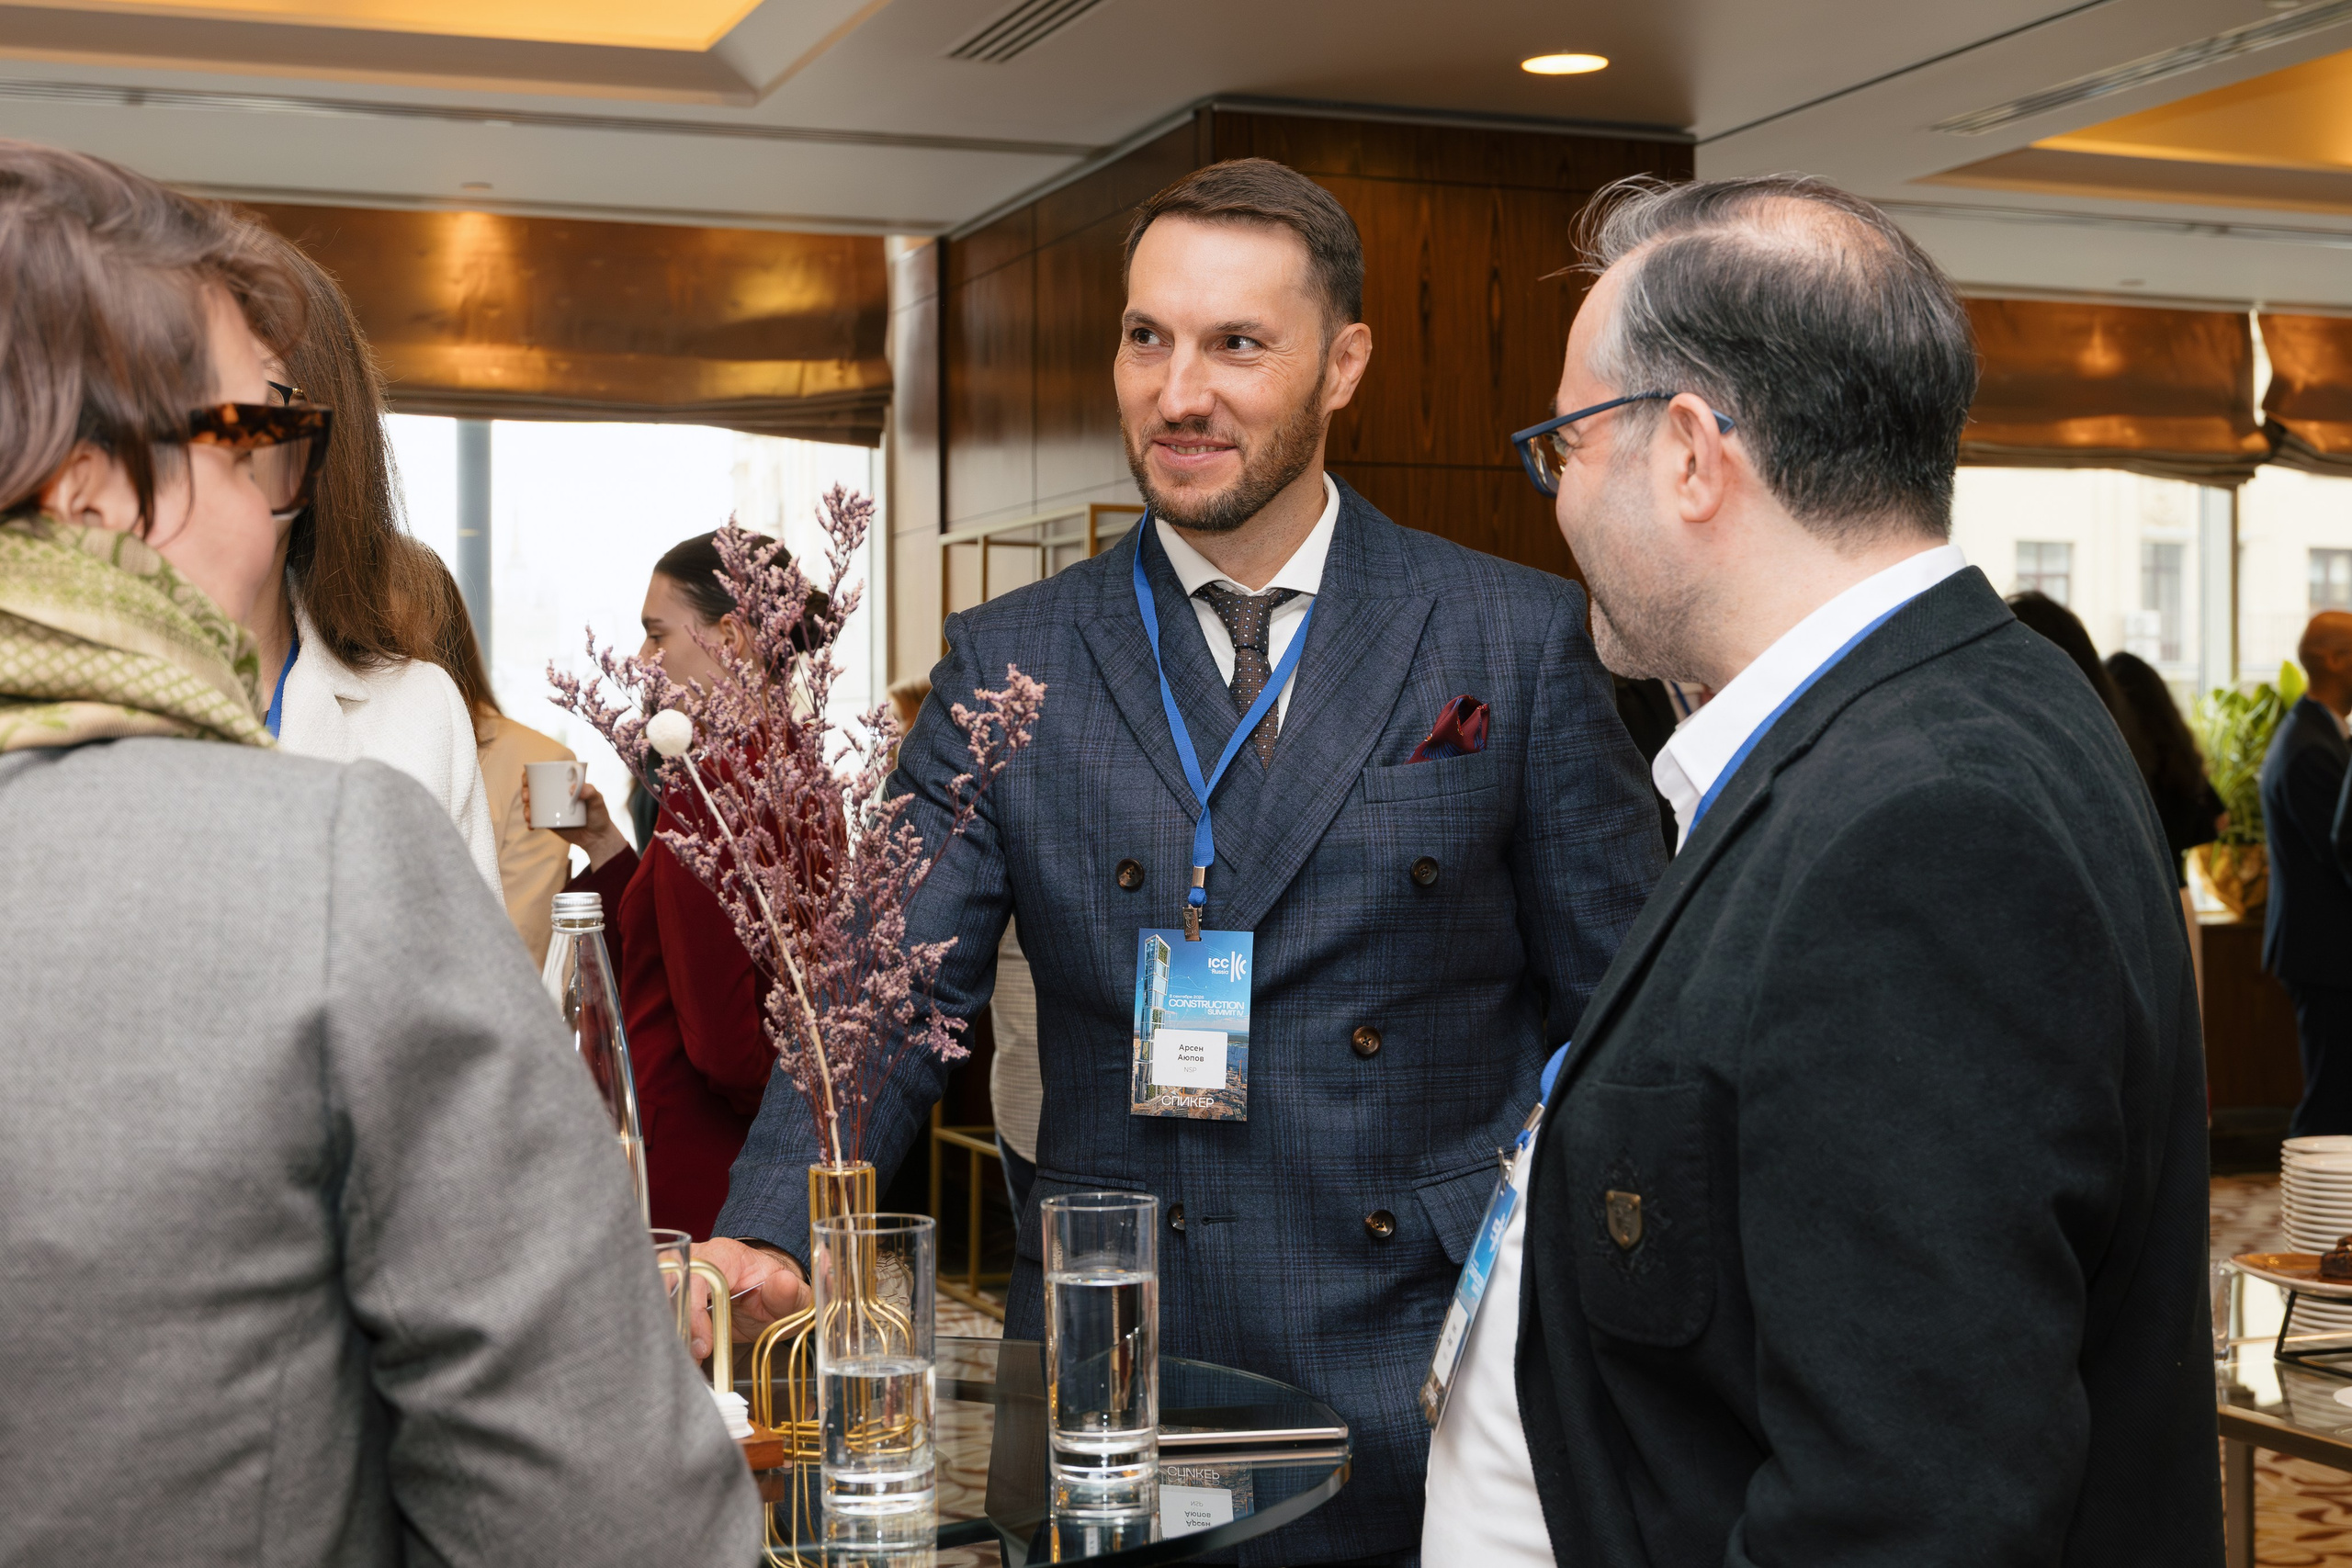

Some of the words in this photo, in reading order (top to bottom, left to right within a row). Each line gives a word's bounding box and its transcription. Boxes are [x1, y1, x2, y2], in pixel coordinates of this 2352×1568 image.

[1207, 957, 1230, 969] ICC
[1168, 998, 1245, 1010] CONSTRUCTION
[1178, 1043, 1204, 1053] Арсен
[1177, 1054, 1204, 1063] Аюпов
[1161, 1095, 1215, 1108] СПИКЕР
